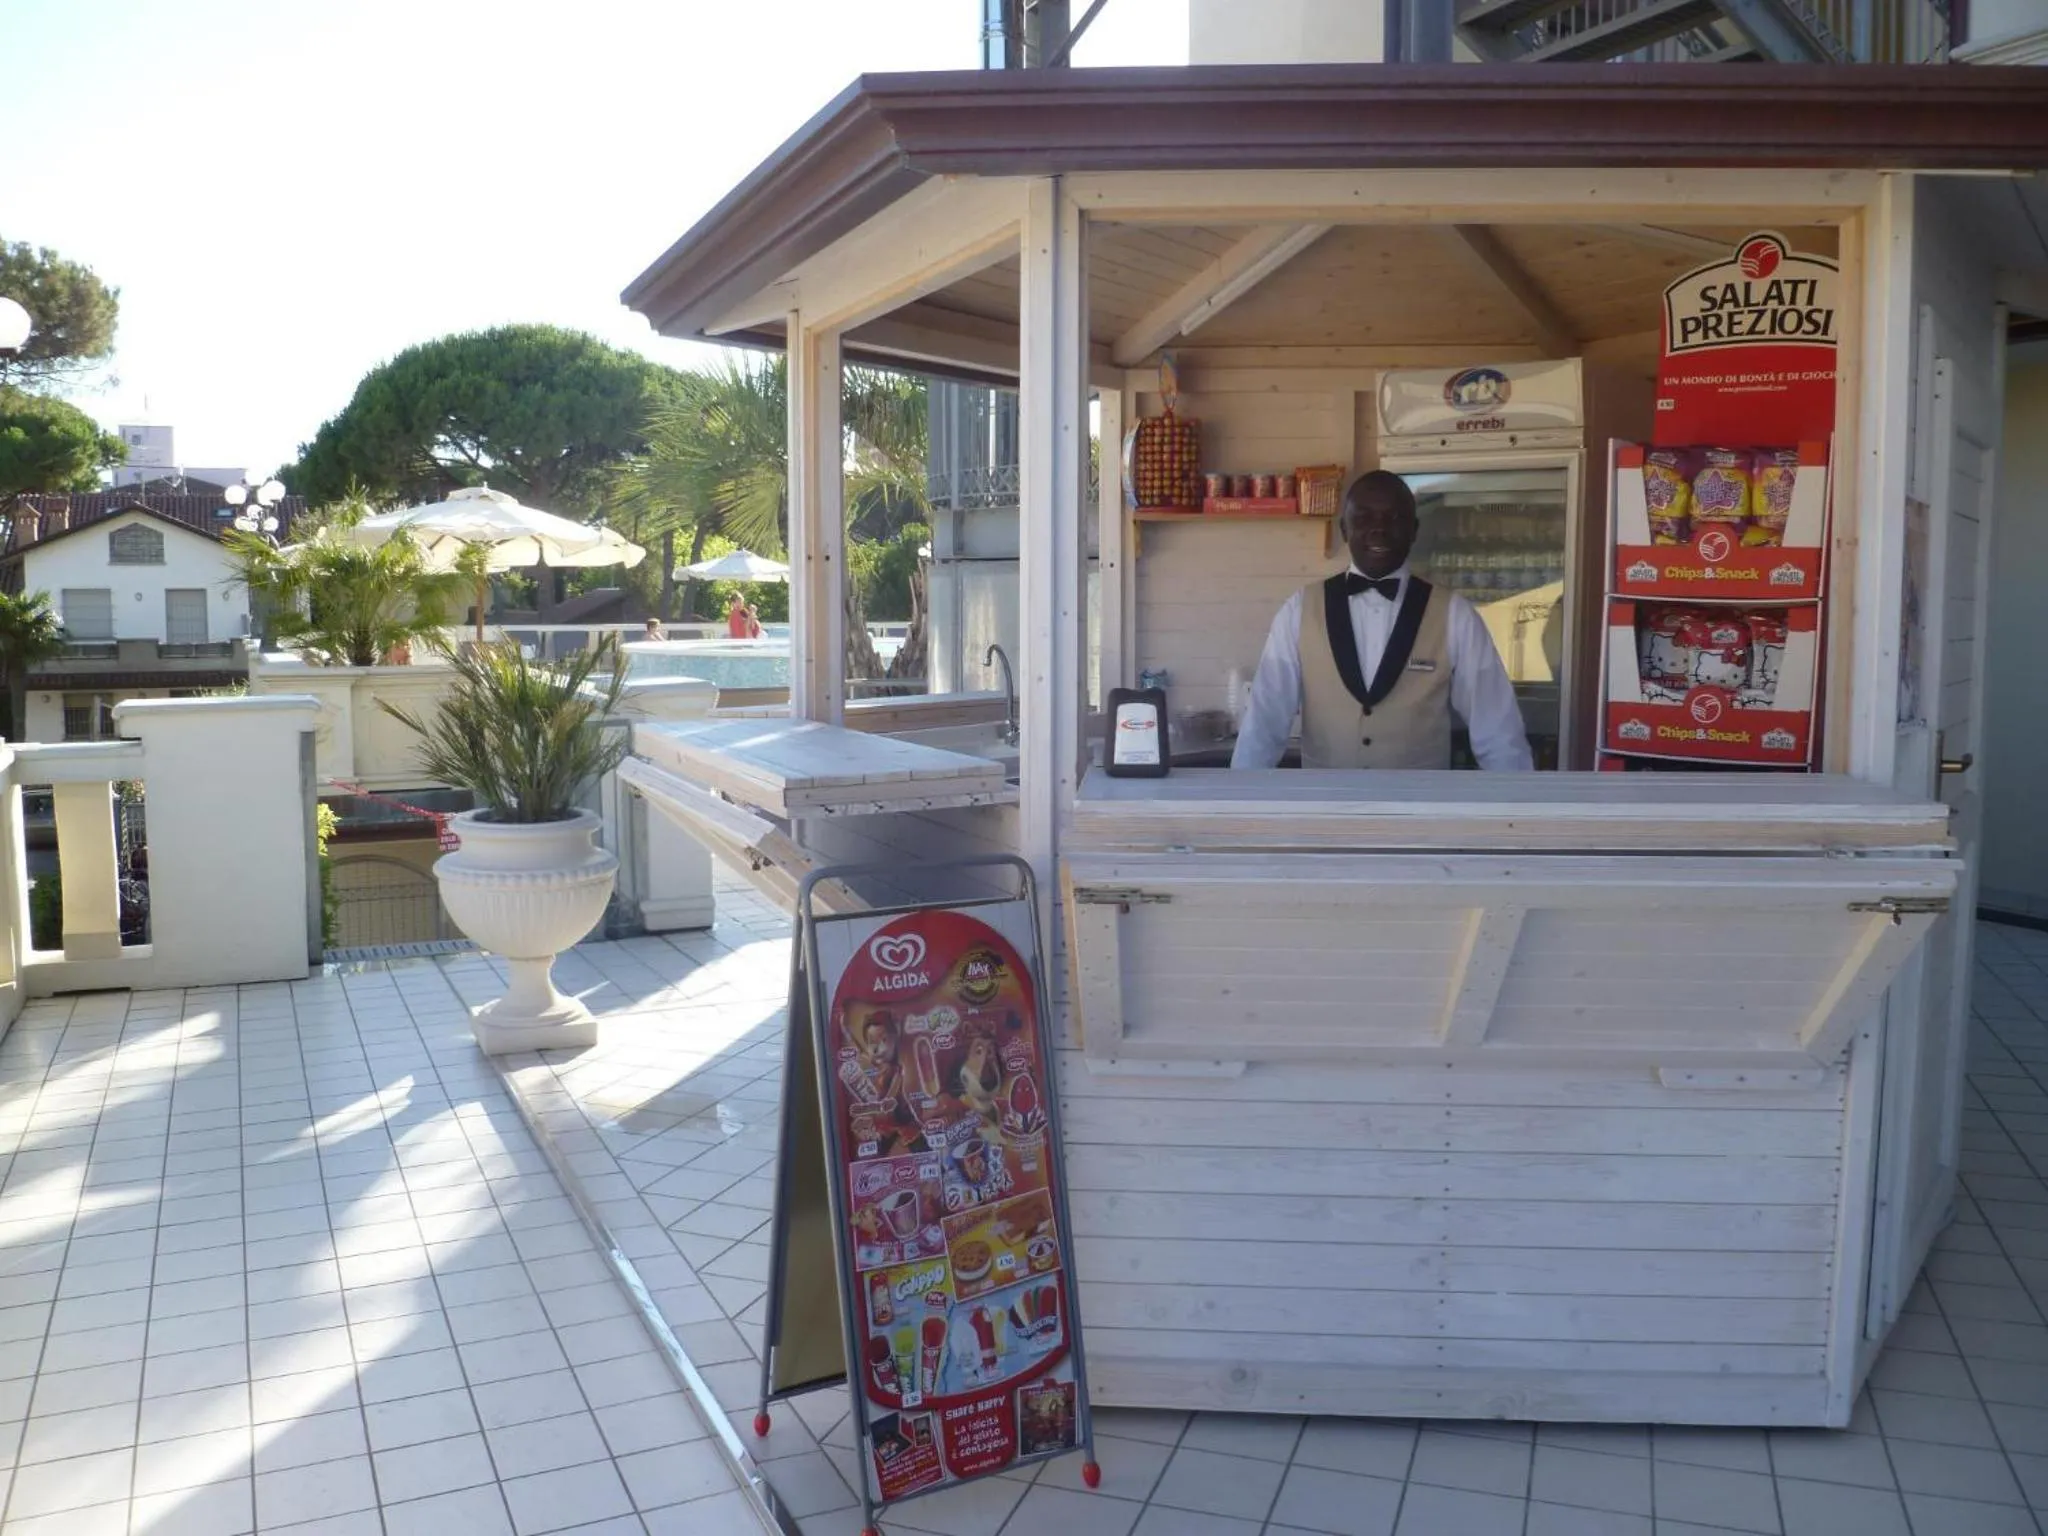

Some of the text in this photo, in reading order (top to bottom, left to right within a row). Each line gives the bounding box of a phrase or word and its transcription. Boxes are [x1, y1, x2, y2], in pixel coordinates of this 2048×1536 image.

[1699, 279, 1818, 313] SALATI
[1679, 308, 1834, 344] PREZIOSI
[1663, 376, 1680, 386] UN
[1681, 375, 1722, 385] MONDO
[1725, 374, 1737, 383] DI
[1787, 372, 1799, 381] DI
[1456, 417, 1506, 431] errebi
[1664, 566, 1759, 581] Chips&Snack
[1657, 726, 1751, 743] Chips&Snack
[873, 972, 929, 992] ALGIDA
